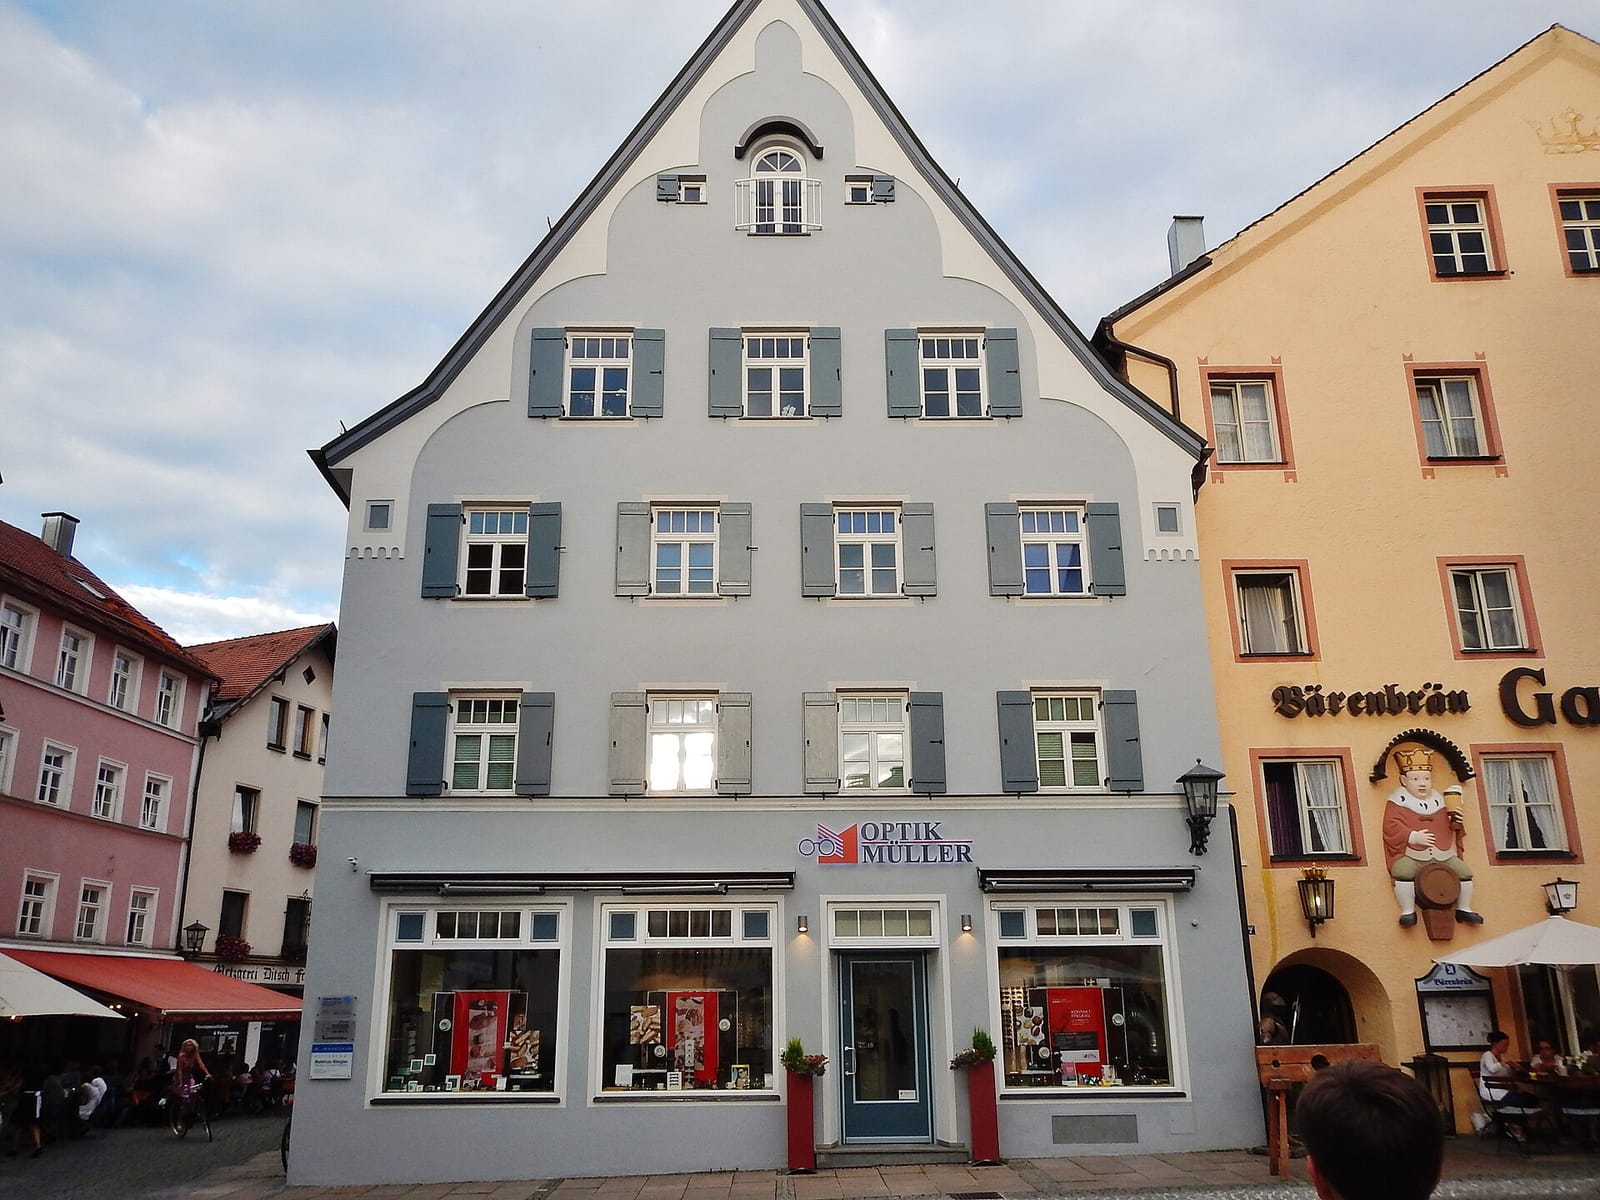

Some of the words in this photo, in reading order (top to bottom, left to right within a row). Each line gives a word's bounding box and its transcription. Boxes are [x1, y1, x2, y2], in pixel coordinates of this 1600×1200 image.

[1271, 682, 1472, 718] Bärenbräu
[860, 822, 943, 841] OPTIK
[862, 840, 974, 863] MÜLLER
[263, 967, 290, 981] Ditsch
